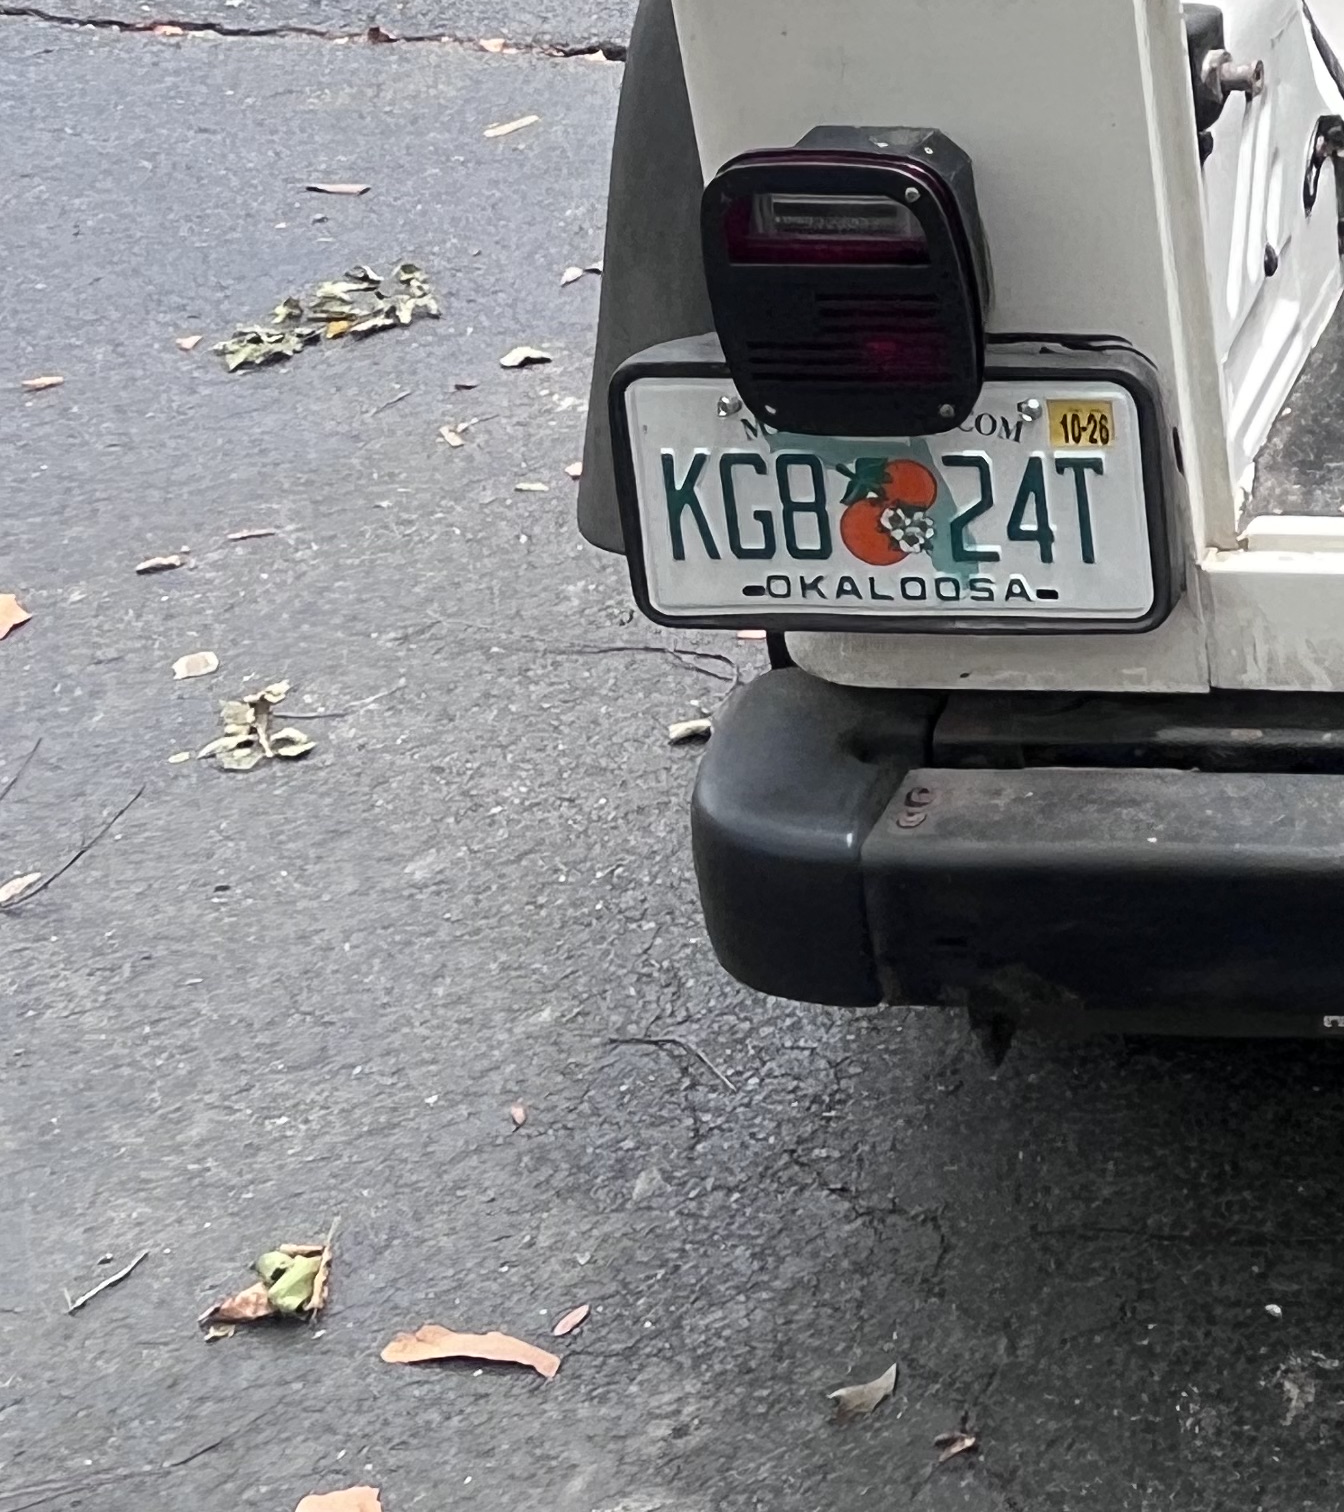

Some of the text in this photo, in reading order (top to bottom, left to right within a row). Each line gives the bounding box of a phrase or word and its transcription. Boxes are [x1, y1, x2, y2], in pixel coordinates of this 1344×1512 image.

[1060, 413, 1110, 445] 10-26
[941, 455, 1104, 564] 24T
[766, 574, 1035, 602] OKALOOSA
